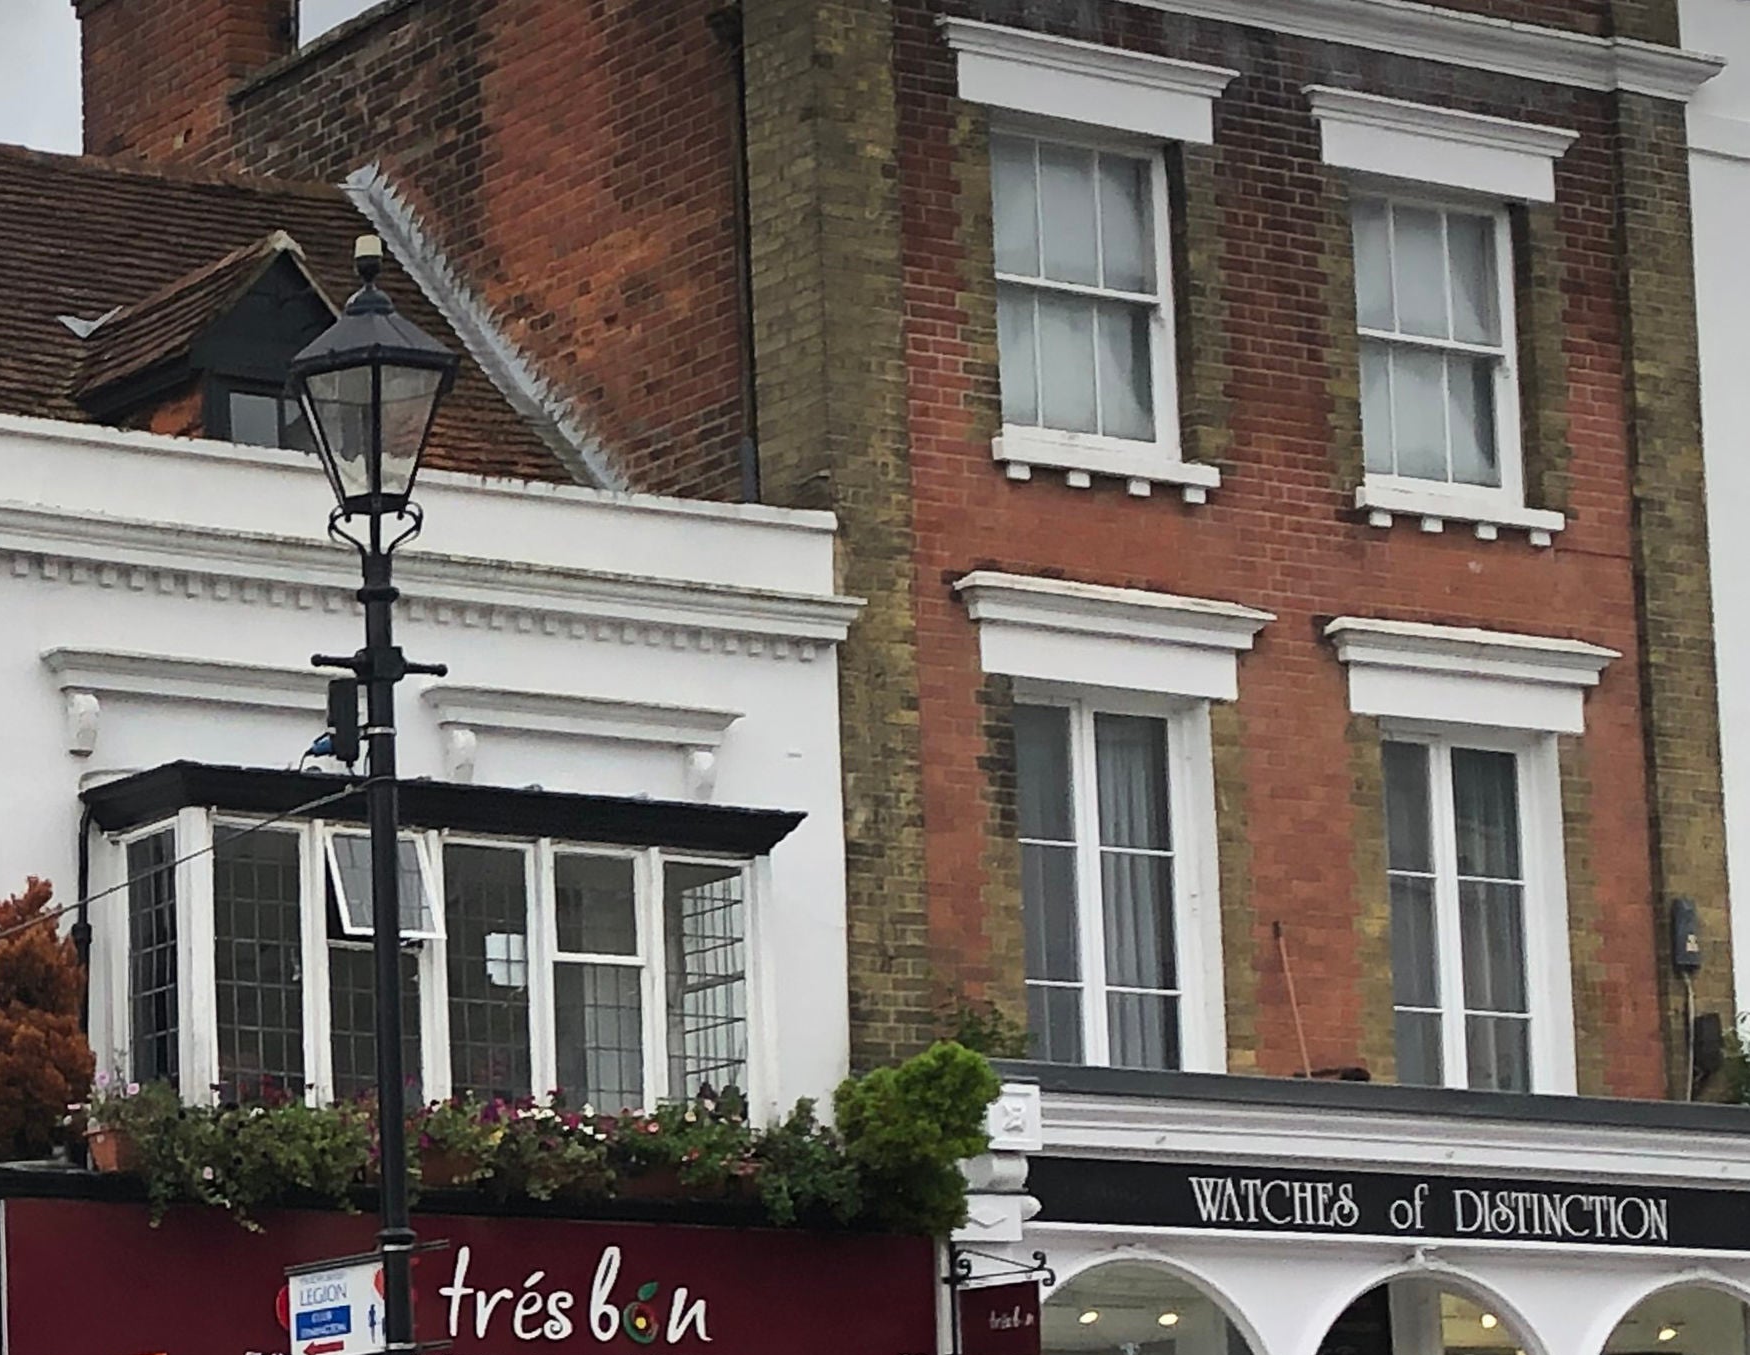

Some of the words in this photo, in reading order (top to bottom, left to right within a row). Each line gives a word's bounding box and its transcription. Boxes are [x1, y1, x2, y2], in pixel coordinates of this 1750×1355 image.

[1188, 1176, 1360, 1228] WATCHES
[1389, 1183, 1430, 1230] of
[1452, 1188, 1669, 1241] DISTINCTION
[299, 1282, 347, 1307] LEGION
